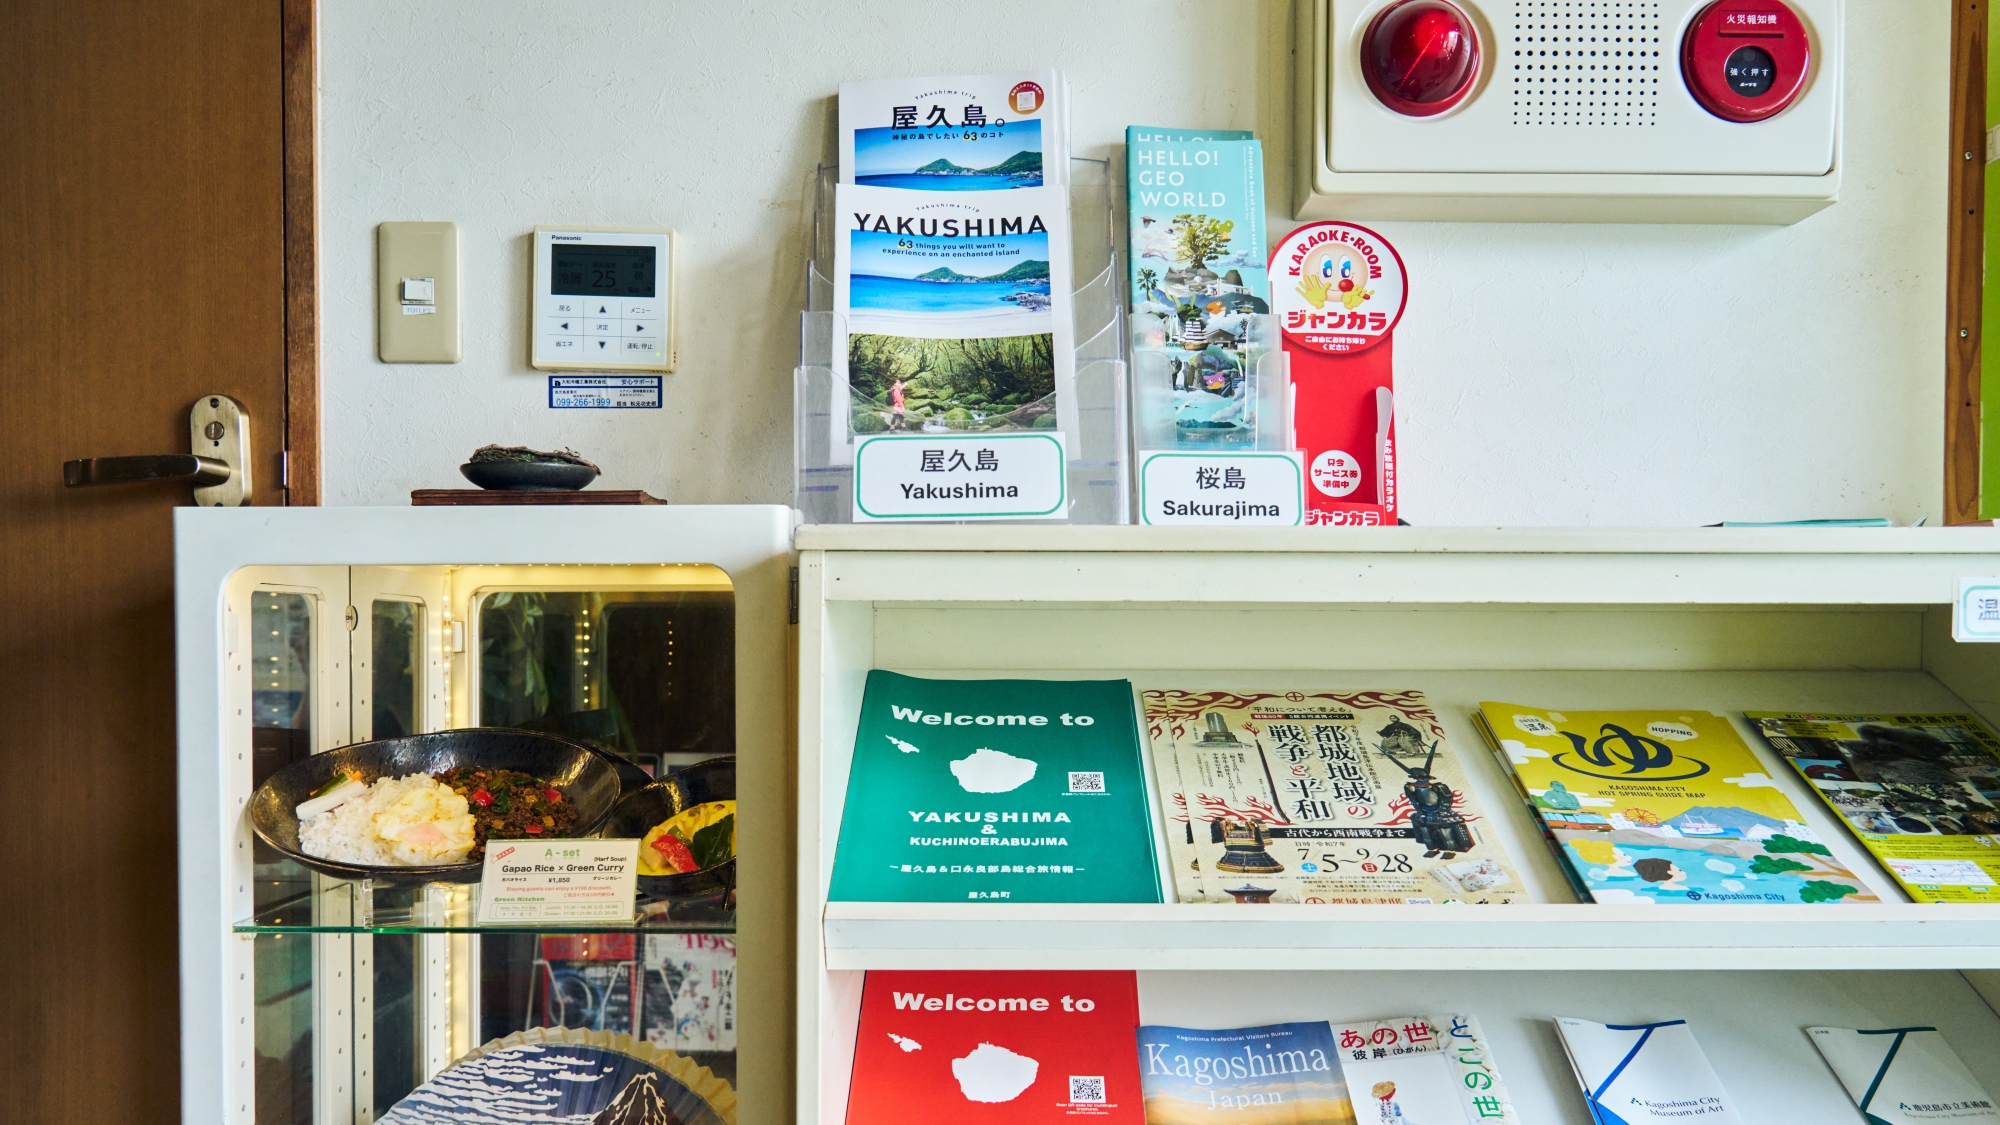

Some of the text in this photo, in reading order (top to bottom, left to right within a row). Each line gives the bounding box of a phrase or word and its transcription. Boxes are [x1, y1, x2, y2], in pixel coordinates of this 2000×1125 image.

[1726, 14, 1778, 25] 火災報知機
[1729, 67, 1769, 77] 強く押す
[914, 89, 977, 100] Yakushima trip
[1138, 150, 1219, 166] HELLO!
[1139, 171, 1185, 187] GEO
[1139, 191, 1226, 208] WORLD
[853, 212, 1048, 238] YAKUSHIMA
[898, 238, 914, 249] 63
[915, 242, 941, 251] things
[882, 248, 926, 257] experience
[995, 248, 1020, 256] island
[558, 272, 582, 285] 冷房
[592, 270, 616, 288] 25
[1287, 310, 1387, 331] ジャンカラ
[626, 342, 653, 350] 運転/停止
[1305, 336, 1366, 345] ご自由にお持ち帰り
[556, 397, 611, 407] 099-266-1999
[919, 447, 1000, 472] 屋久島
[1327, 458, 1345, 467] 只今
[1195, 466, 1246, 490] 桜島
[1314, 469, 1358, 479] サービス券
[1322, 479, 1350, 489] 準備中
[900, 480, 1019, 501] Yakushima
[1163, 499, 1280, 520] Sakurajima
[1306, 510, 1380, 526] ジャンカラ
[891, 704, 1095, 726] Welcome to
[1524, 723, 1551, 732] 温泉
[1651, 726, 1694, 737] HOPPING
[1268, 724, 1332, 819] 戦争と平和
[1313, 724, 1373, 818] 都城地域の
[908, 811, 1071, 823] YAKUSHIMA
[980, 824, 997, 834] &
[1284, 828, 1407, 838] 古代から西南戦争まで
[909, 836, 1069, 847] KUCHINOERABUJIMA
[545, 848, 553, 857] A
[562, 848, 581, 857] set
[502, 865, 532, 874] Gapao
[566, 864, 595, 872] Green
[597, 864, 625, 873] Curry
[967, 891, 1011, 899] 屋久島町
[1703, 892, 1786, 902] Kagoshima City
[892, 991, 1096, 1014] Welcome to
[1176, 1034, 1210, 1042] Kagoshima
[1340, 1021, 1433, 1049] あの世
[1144, 1043, 1331, 1086] Kagoshima
[1207, 1090, 1284, 1111] Japan
[1644, 1096, 1721, 1110] Kagoshima City
[1912, 1099, 1992, 1112] 鹿児島市立美術館
[1649, 1105, 1724, 1117] Museum of Art
